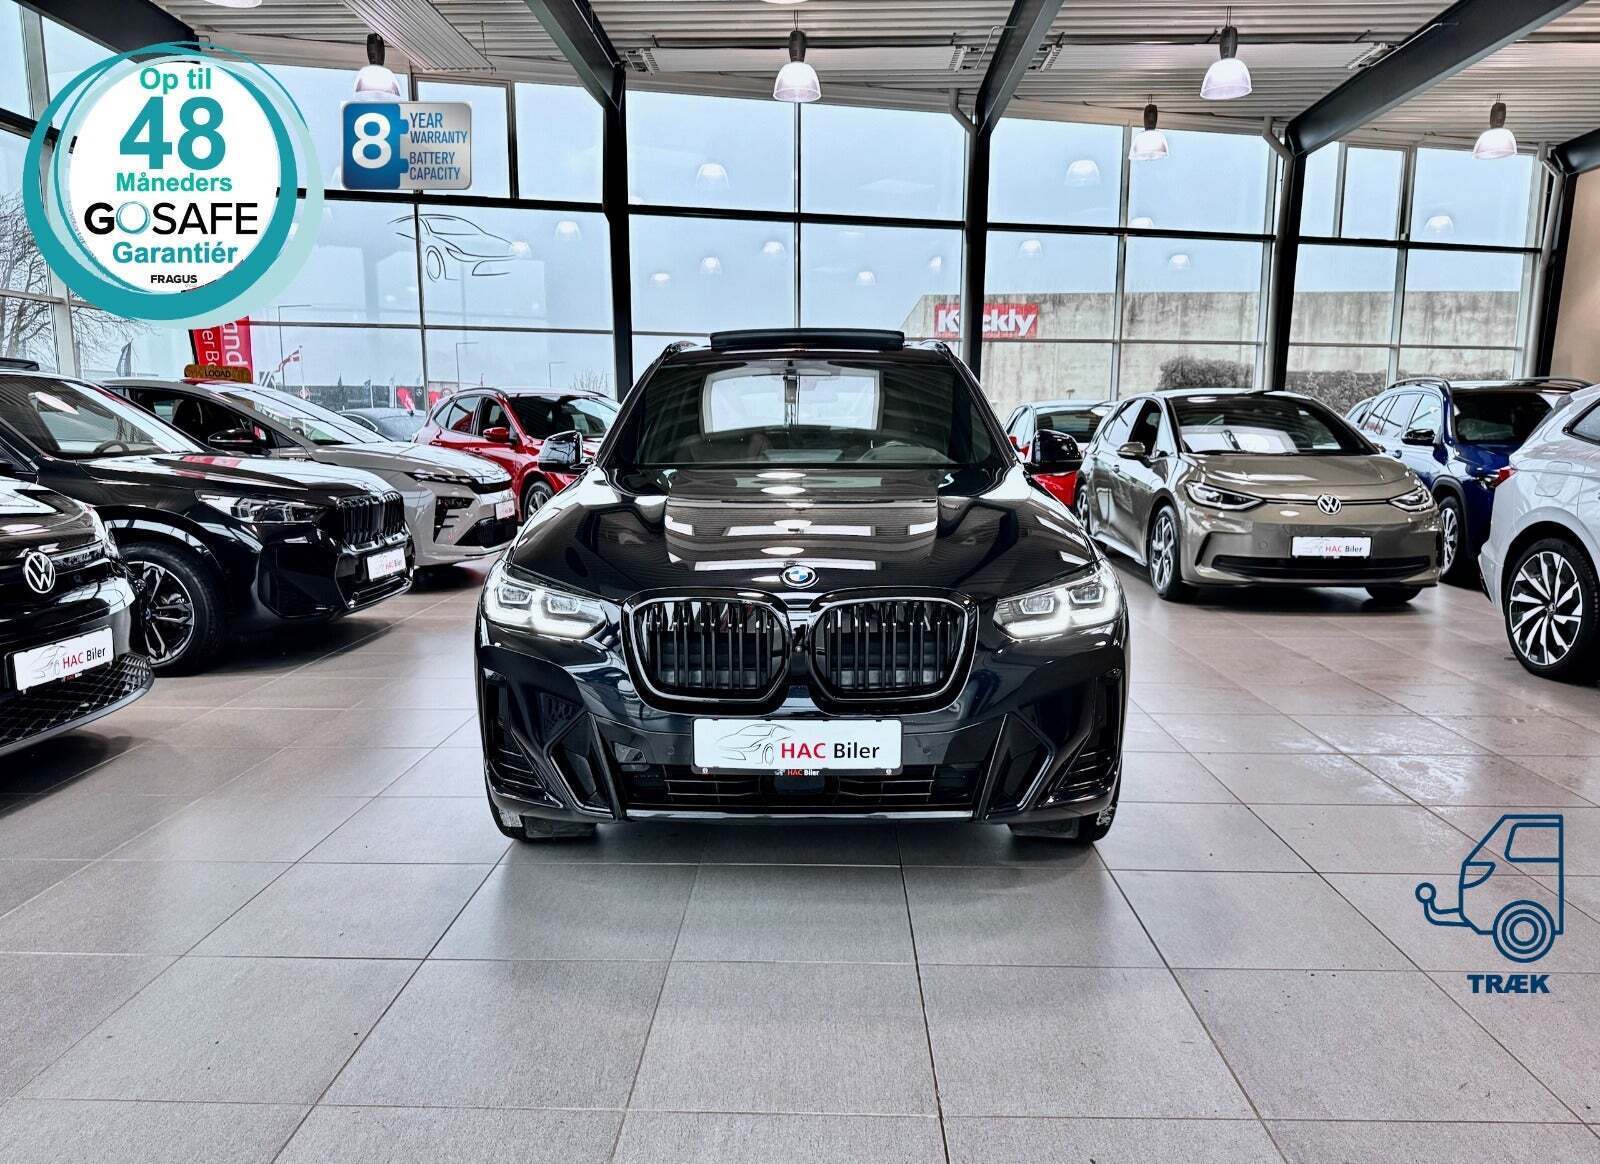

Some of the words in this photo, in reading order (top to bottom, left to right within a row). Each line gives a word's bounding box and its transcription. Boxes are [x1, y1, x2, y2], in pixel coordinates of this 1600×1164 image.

[62, 652, 85, 670] HAC
[86, 647, 106, 662] Biler
[781, 742, 827, 759] HAC
[833, 742, 880, 759] Biler
